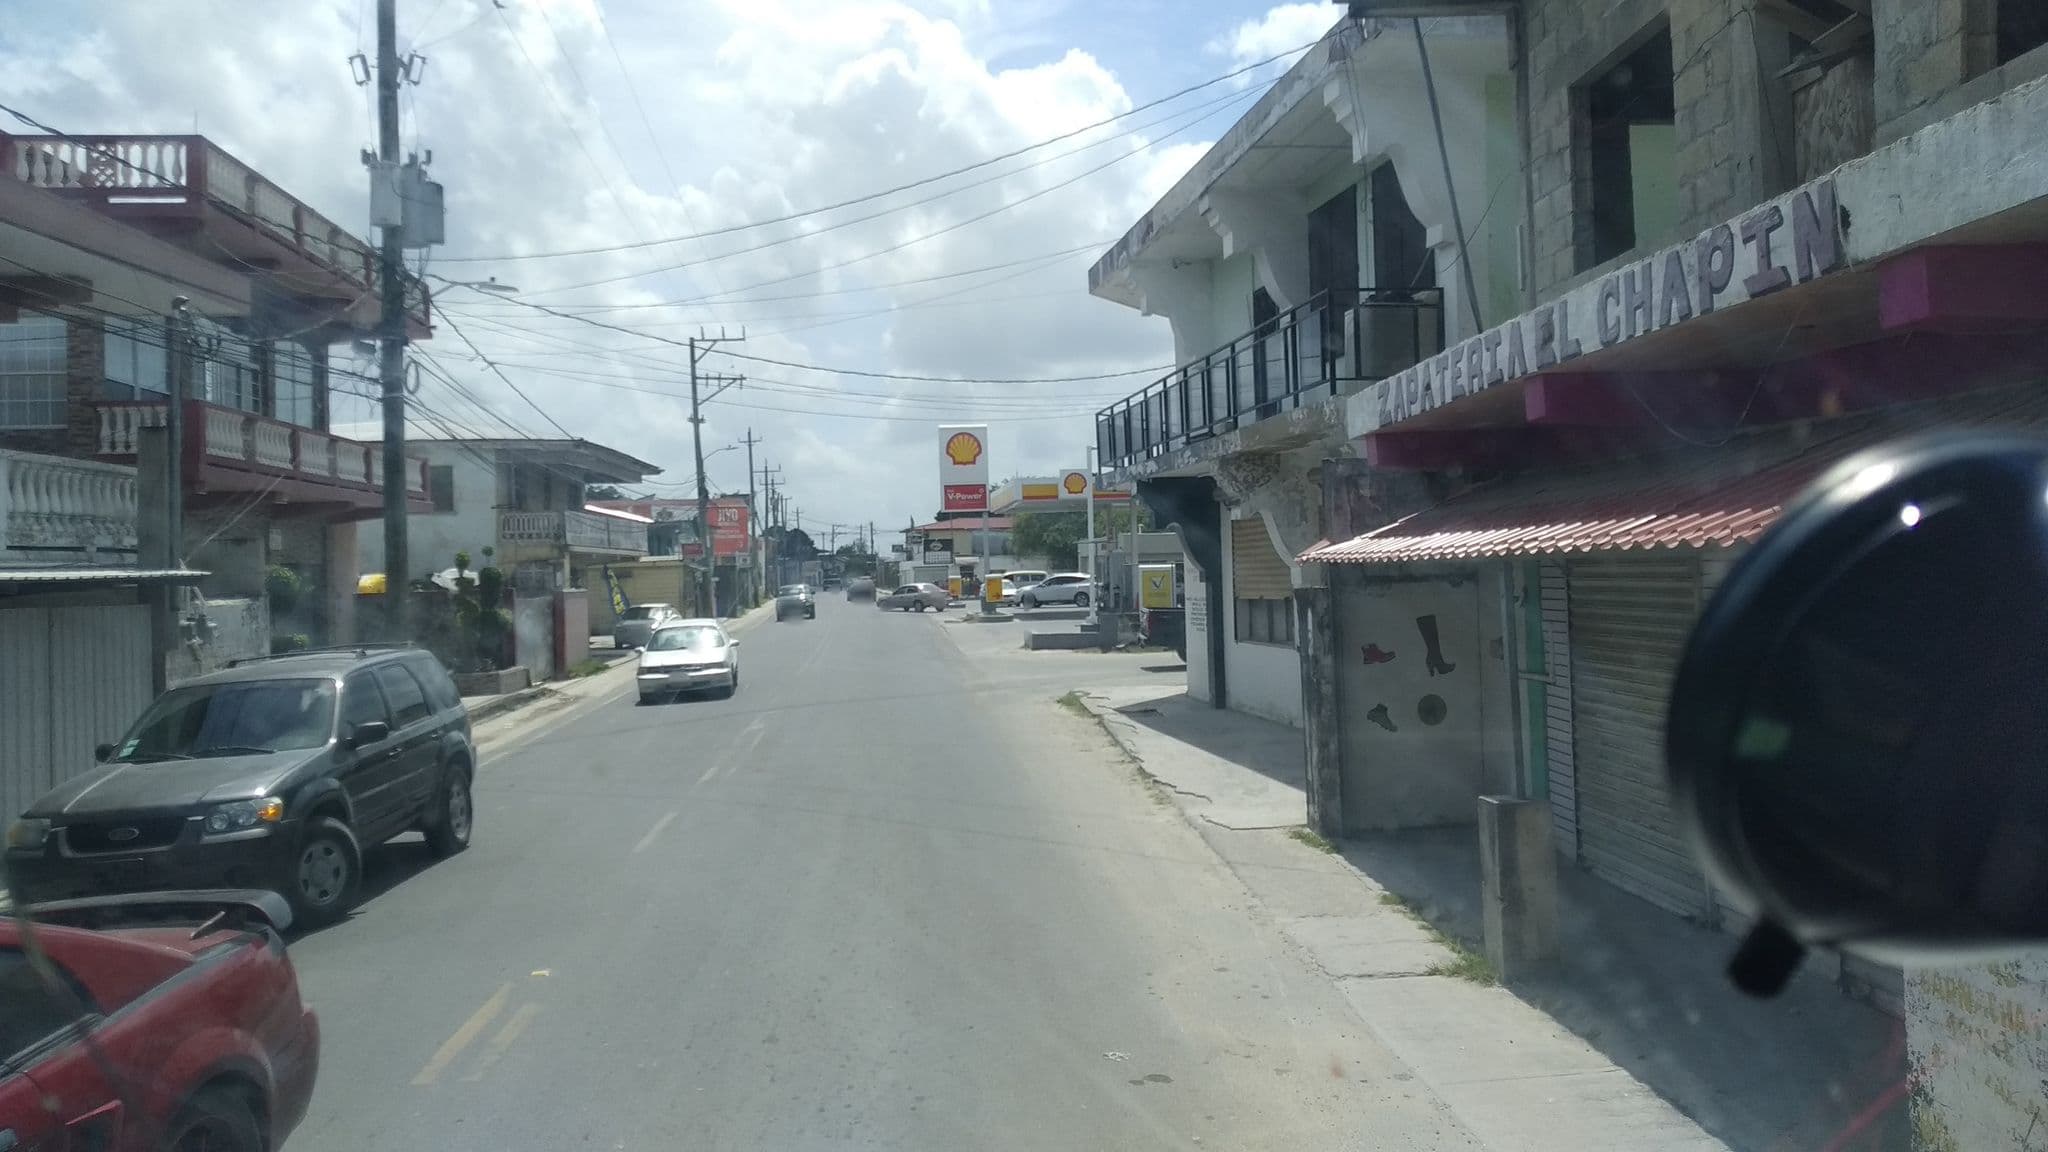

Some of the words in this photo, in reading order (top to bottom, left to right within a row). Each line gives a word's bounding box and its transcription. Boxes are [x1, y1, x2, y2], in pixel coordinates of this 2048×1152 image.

[1377, 321, 1528, 428] ZAPATERIA
[1534, 299, 1583, 368] EL
[1596, 178, 1840, 347] CHAPIN
[947, 492, 983, 500] V-Power
